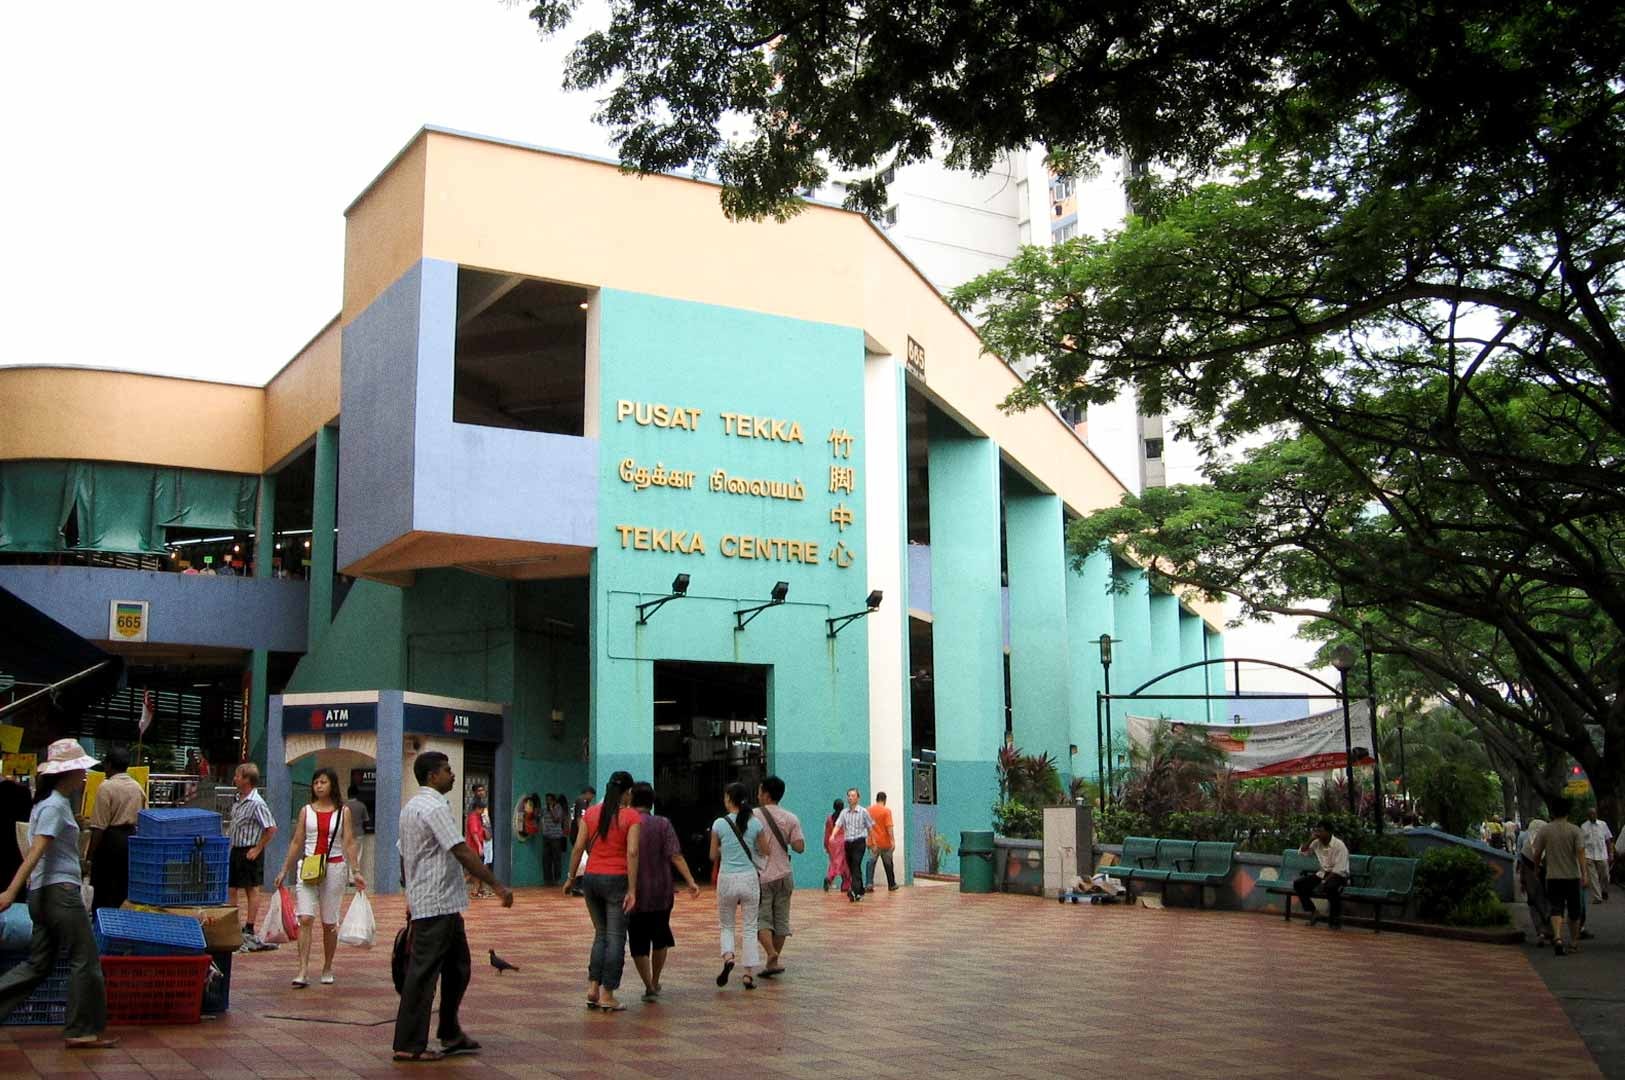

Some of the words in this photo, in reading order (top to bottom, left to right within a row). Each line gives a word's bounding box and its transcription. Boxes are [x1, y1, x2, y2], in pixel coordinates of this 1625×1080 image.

[617, 400, 701, 430] PUSAT
[720, 412, 804, 443] TEKKA
[619, 457, 695, 491] தேக்கா
[709, 467, 806, 501] நிலையம்
[616, 525, 705, 555] TEKKA
[720, 535, 819, 564] CENTRE
[117, 615, 141, 628] 665
[326, 709, 349, 721] ATM
[454, 714, 469, 727] ATM
